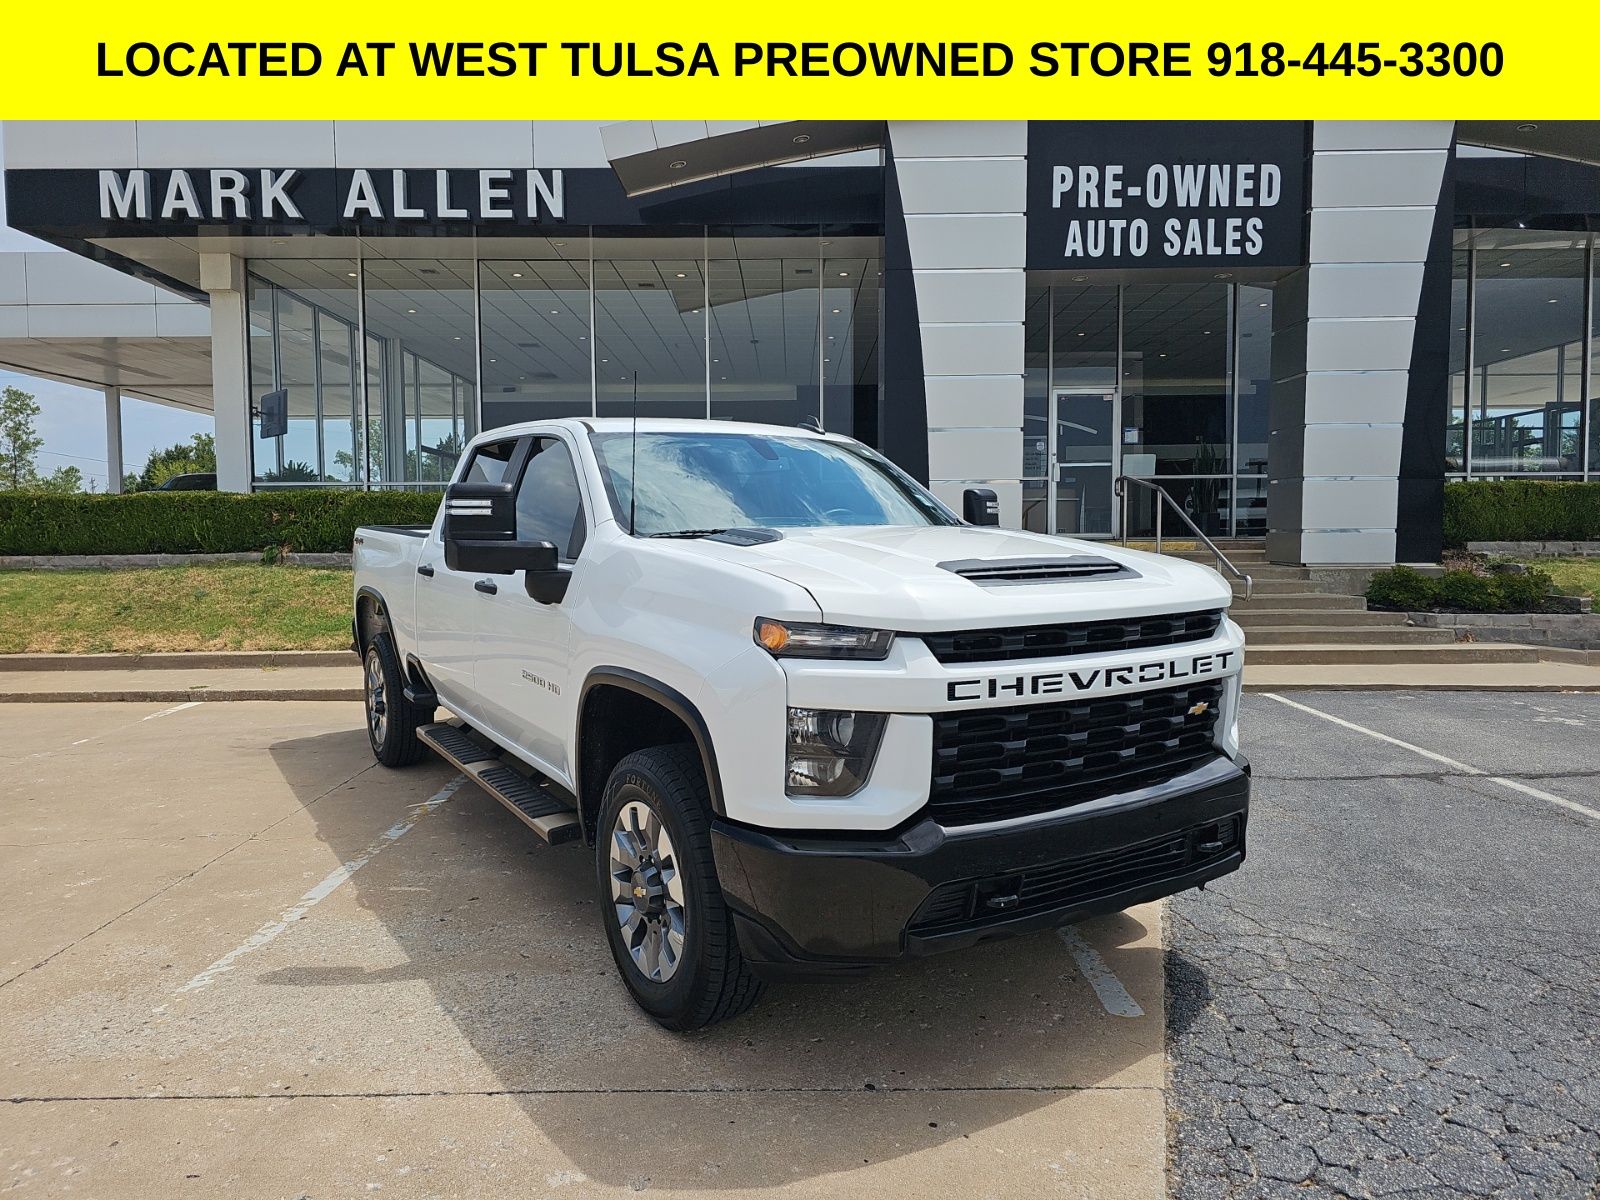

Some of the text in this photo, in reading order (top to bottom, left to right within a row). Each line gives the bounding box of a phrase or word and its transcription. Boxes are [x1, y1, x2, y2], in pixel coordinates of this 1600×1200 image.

[98, 168, 566, 221] MARK ALLEN
[1051, 163, 1282, 209] PRE-OWNED
[1064, 217, 1264, 258] AUTO SALES
[521, 669, 561, 696] 2500 HD
[946, 651, 1234, 702] CHEVROLET
